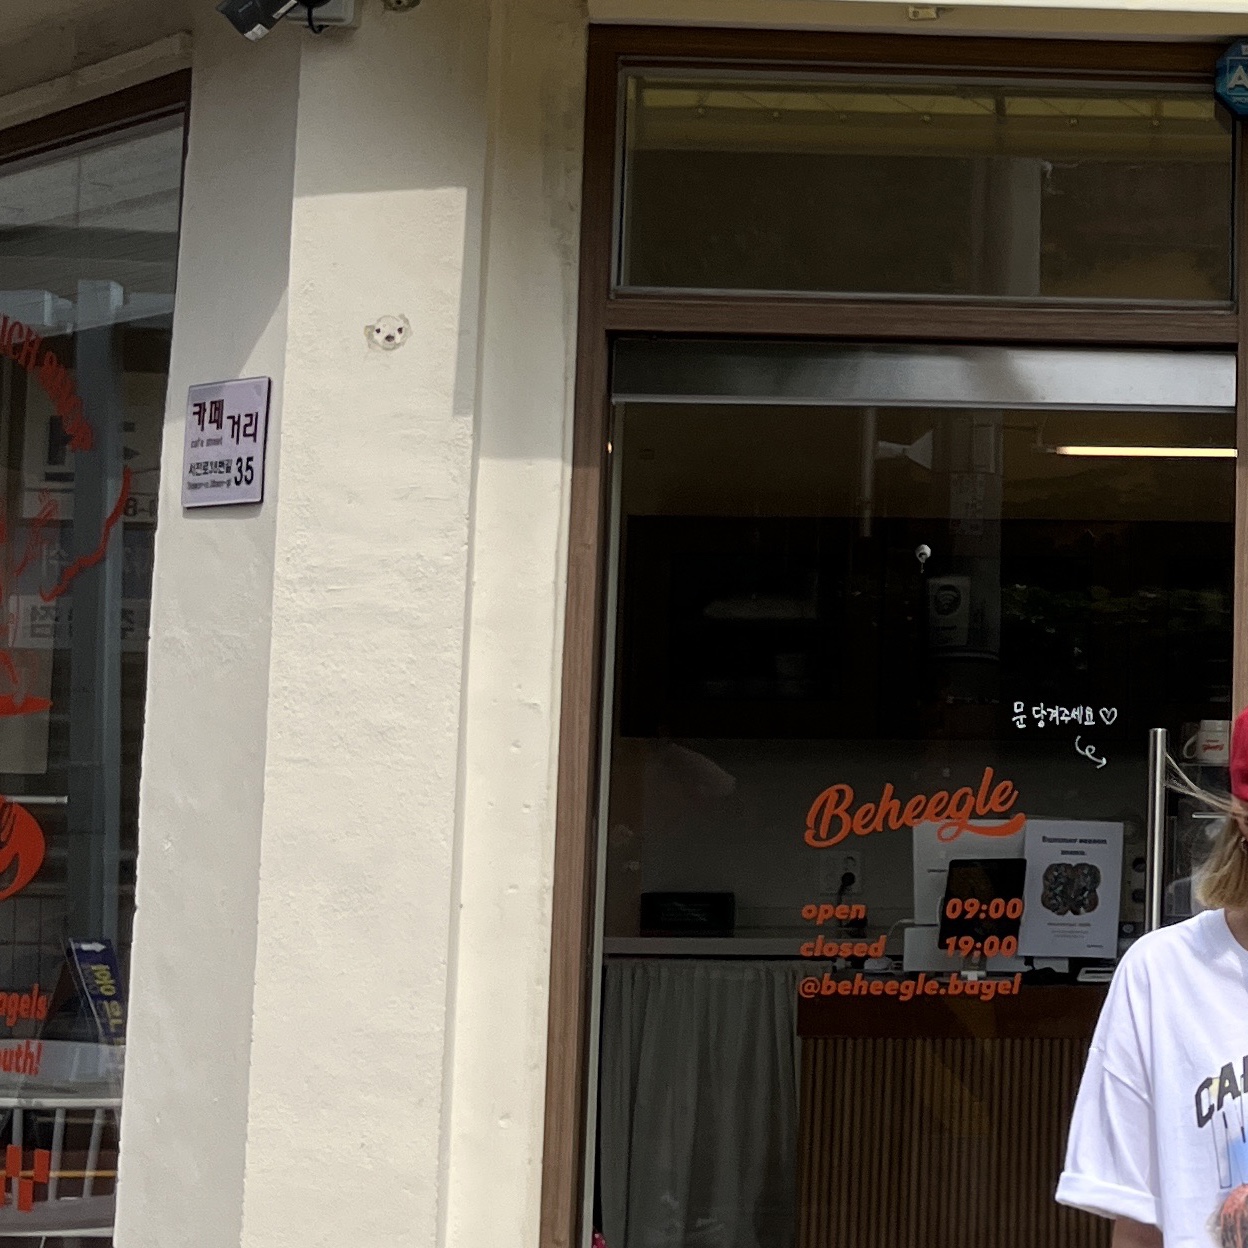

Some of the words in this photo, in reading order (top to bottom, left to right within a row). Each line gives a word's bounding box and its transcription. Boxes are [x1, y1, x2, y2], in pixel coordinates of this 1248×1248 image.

[226, 411, 259, 445] 거리
[234, 456, 255, 487] 35
[1011, 700, 1028, 729] 문
[803, 766, 1027, 849] Beheegle
[800, 902, 867, 927] open
[945, 897, 1024, 921] 09:00
[799, 934, 888, 960] closed
[945, 935, 1019, 959] 19:00
[798, 972, 1023, 1002] @beheegle.bagel
[0, 1038, 43, 1076] uth!
